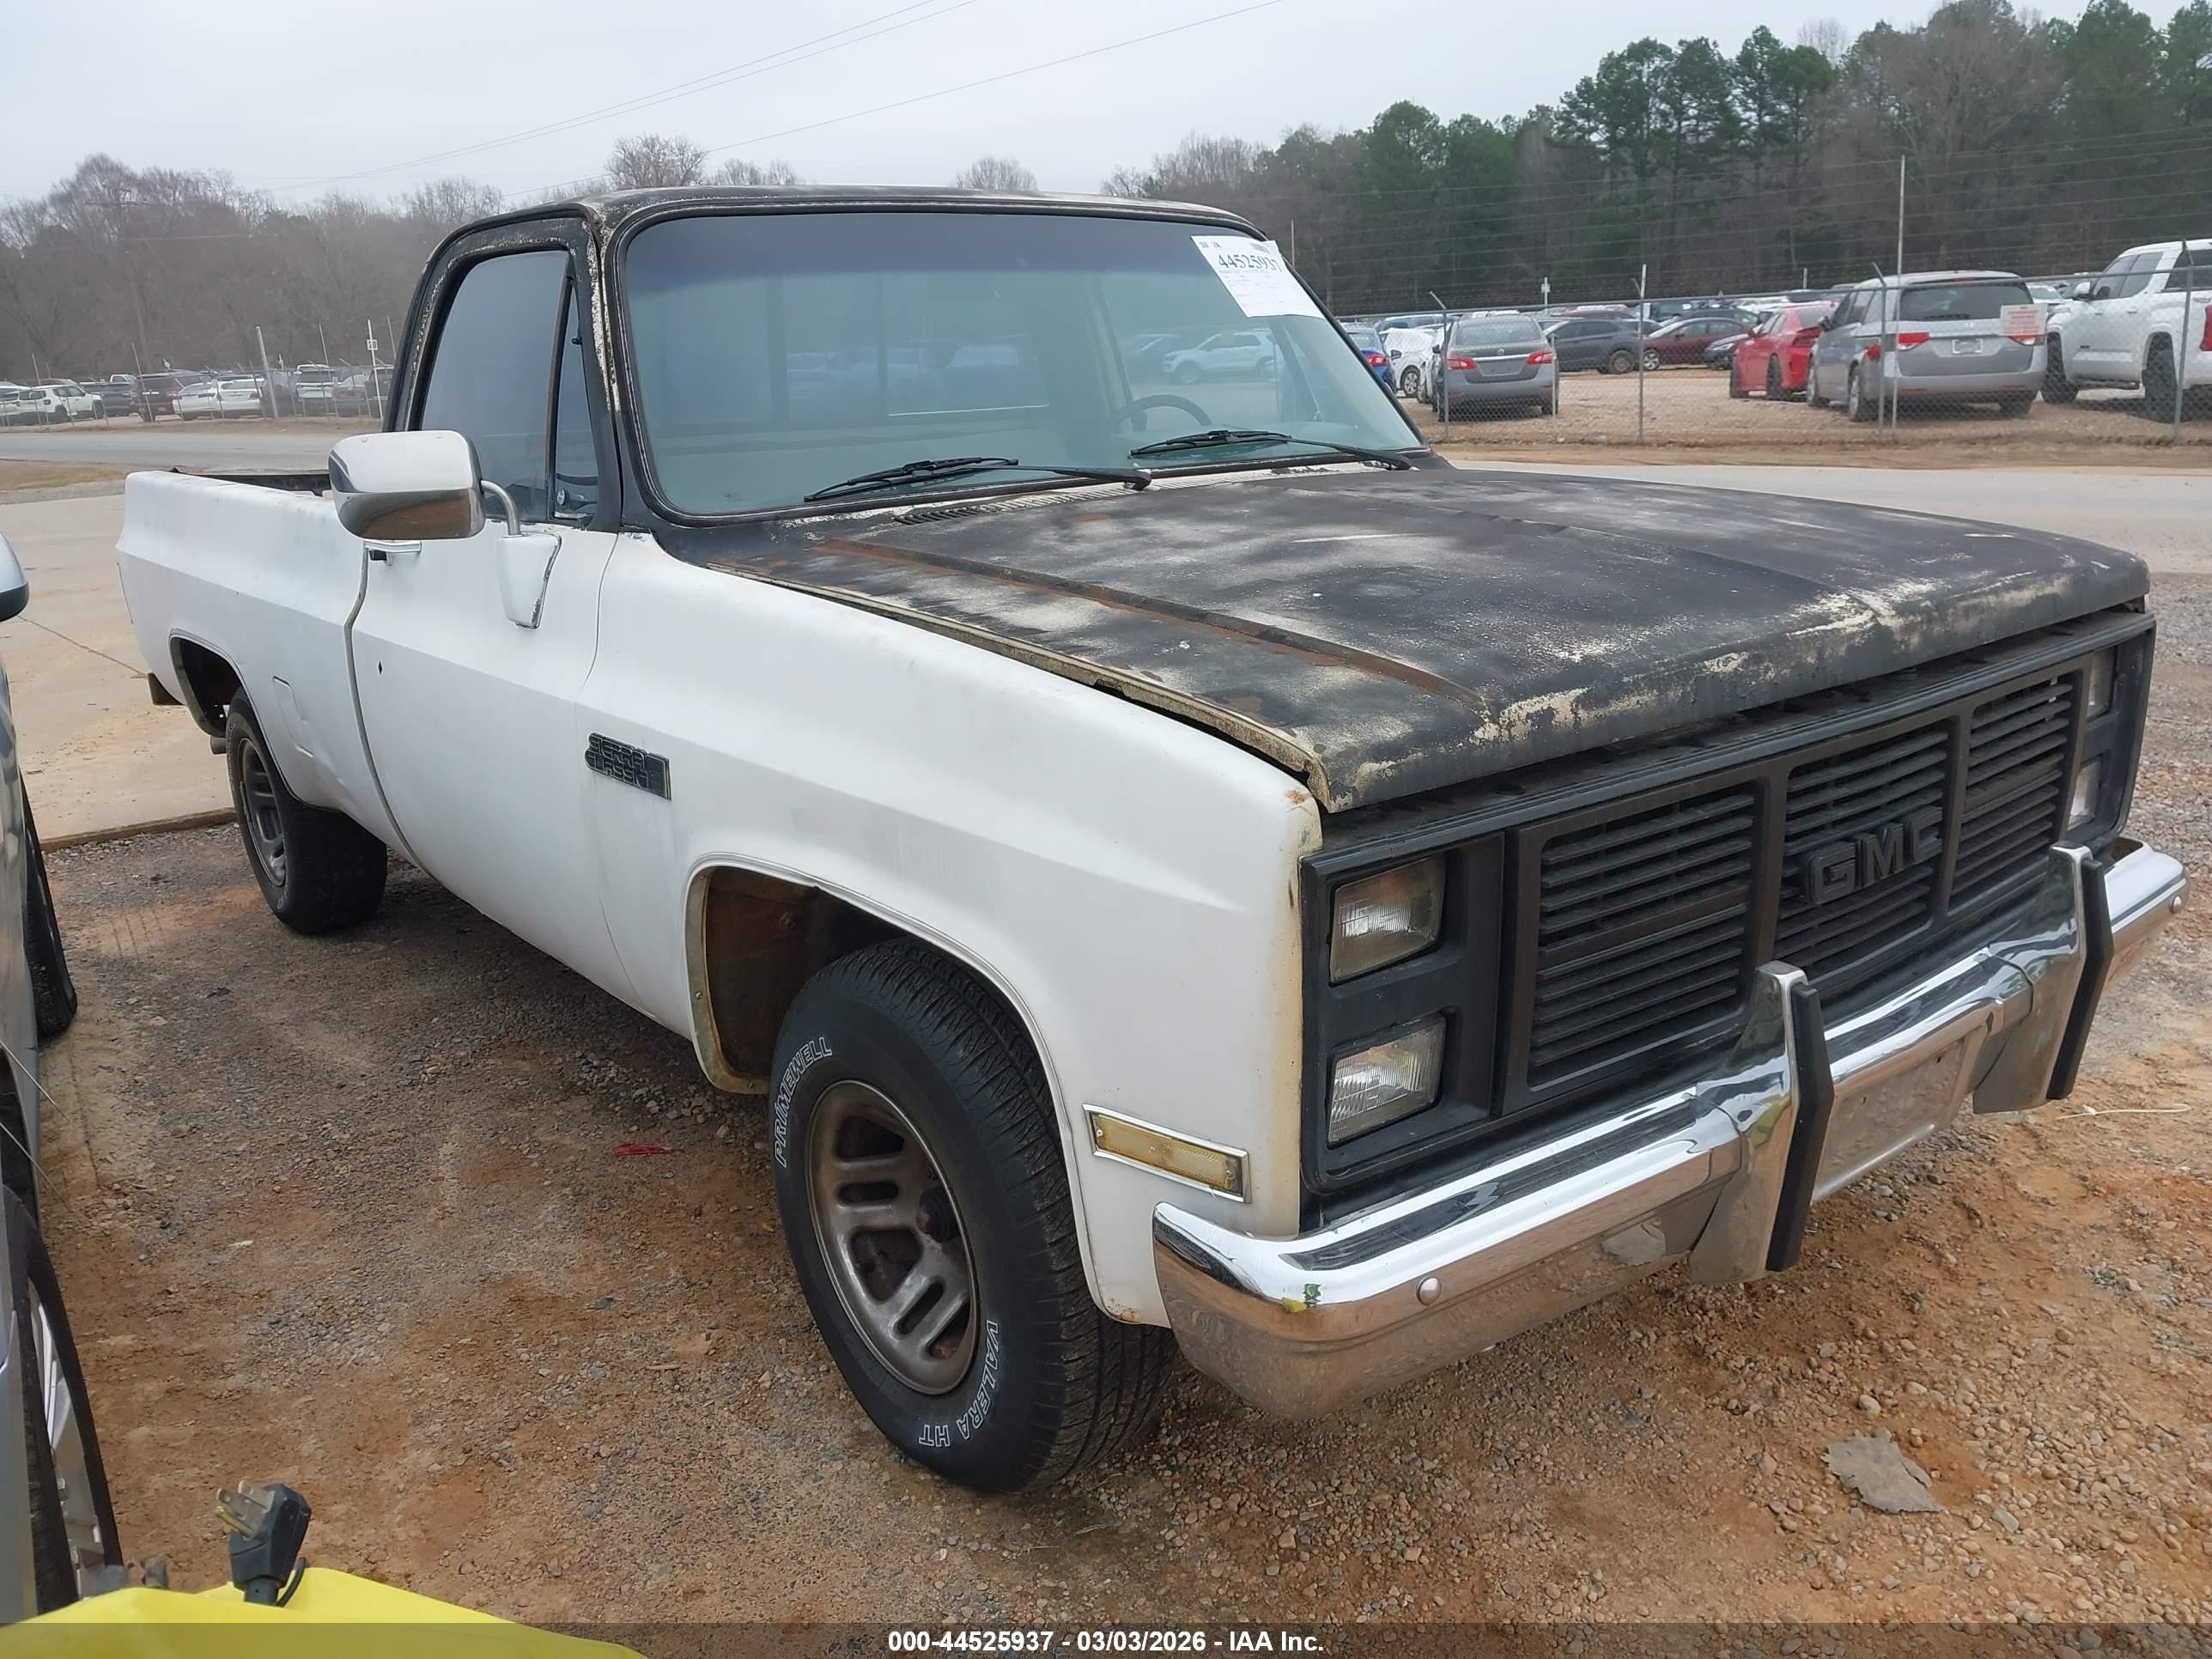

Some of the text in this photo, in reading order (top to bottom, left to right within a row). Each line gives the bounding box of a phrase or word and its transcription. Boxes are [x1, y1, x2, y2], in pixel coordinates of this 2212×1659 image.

[1218, 254, 1283, 272] 44525937
[1808, 805, 1942, 903] GMC
[774, 1036, 833, 1169] PRIMEWELL
[919, 1319, 999, 1447] VALERA HT
